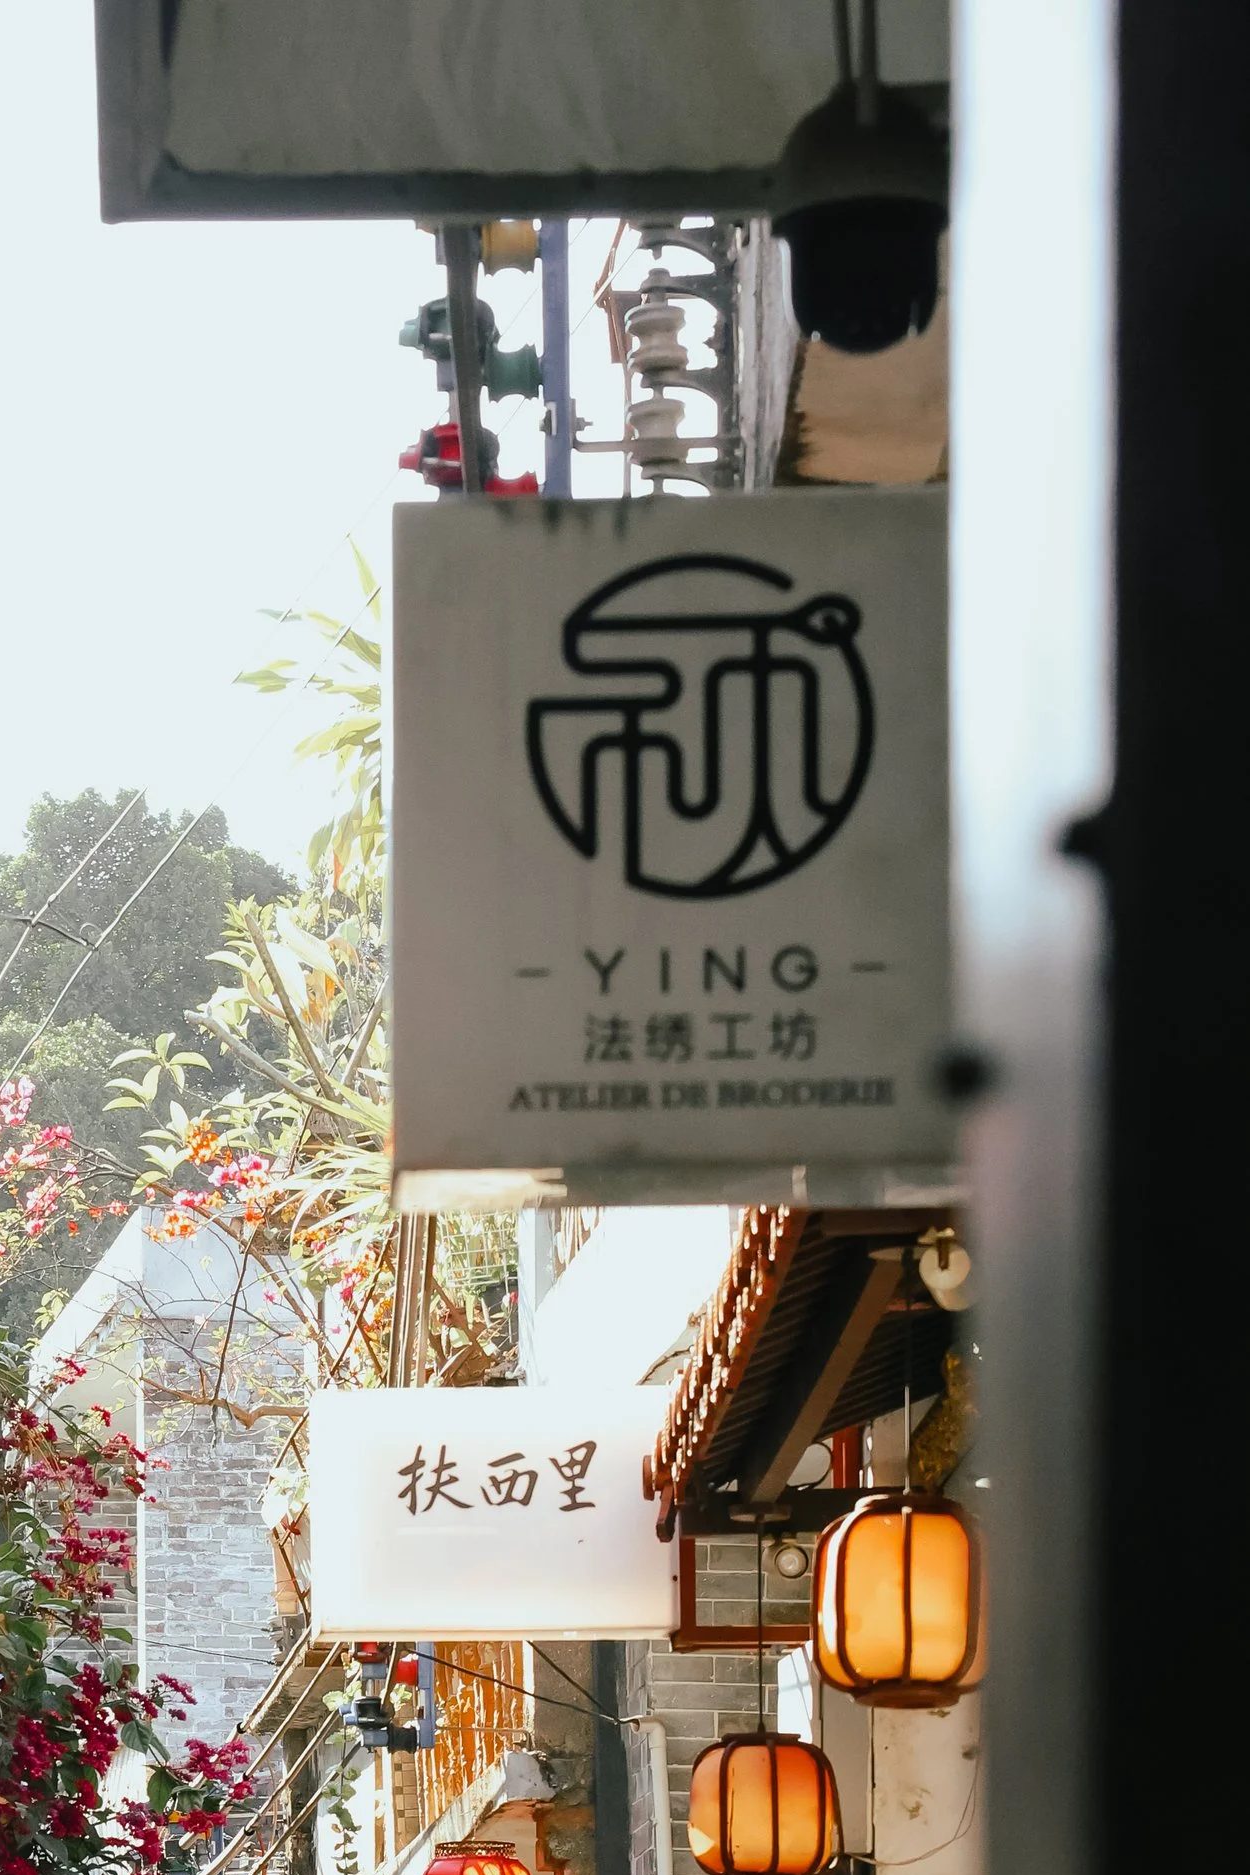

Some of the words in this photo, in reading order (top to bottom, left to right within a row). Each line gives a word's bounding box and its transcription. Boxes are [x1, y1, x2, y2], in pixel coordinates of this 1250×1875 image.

[582, 944, 819, 997] YING
[582, 1007, 819, 1065] 法绣工坊
[396, 1439, 598, 1517] 扶西里
